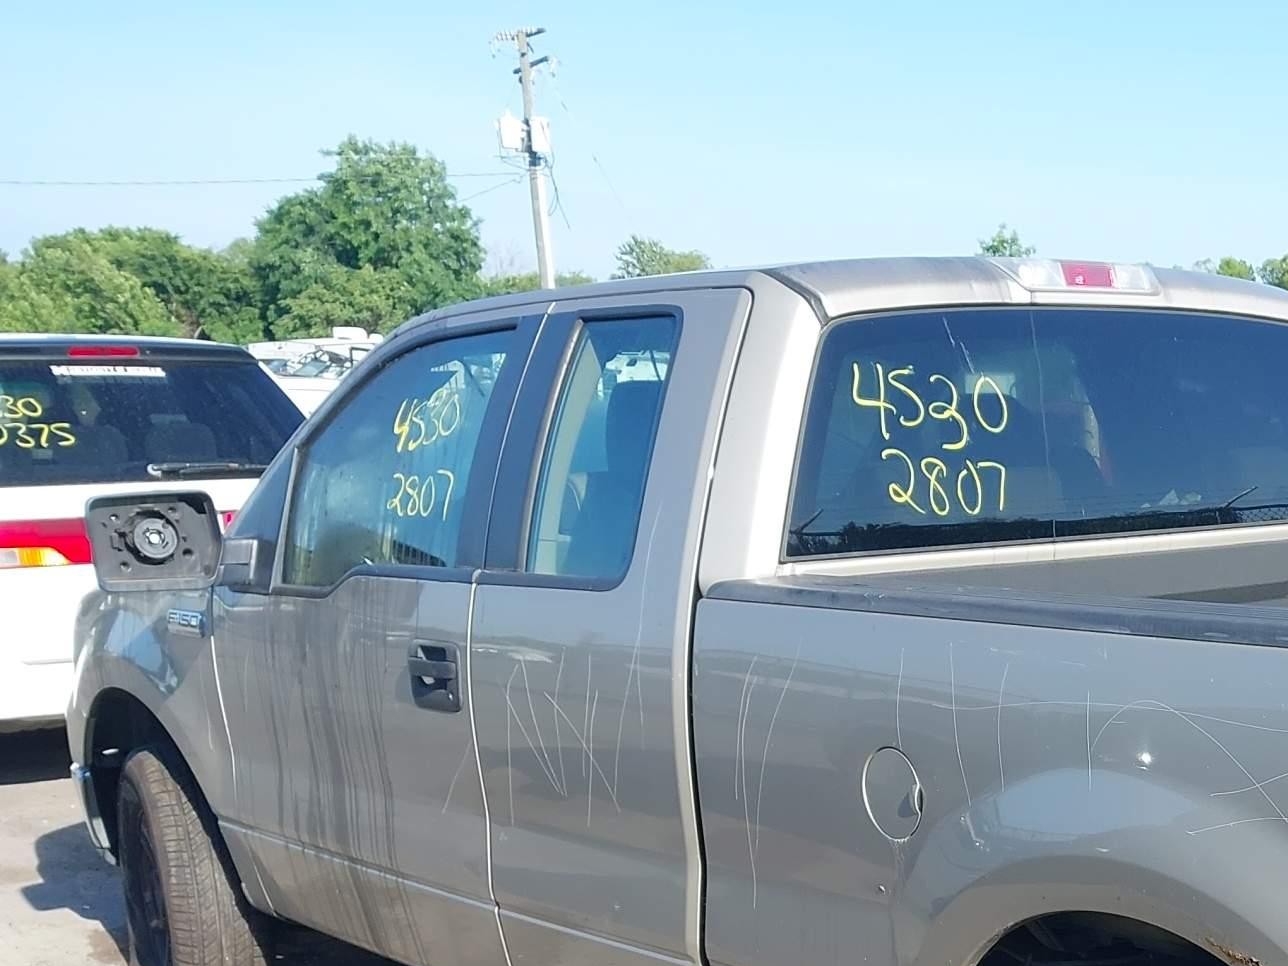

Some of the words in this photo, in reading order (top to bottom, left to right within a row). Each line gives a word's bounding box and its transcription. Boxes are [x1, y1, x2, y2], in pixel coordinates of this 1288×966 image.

[394, 387, 460, 453] 4530
[852, 362, 1008, 450] 4530
[386, 469, 454, 521] 2807
[881, 448, 1006, 516] 2807
